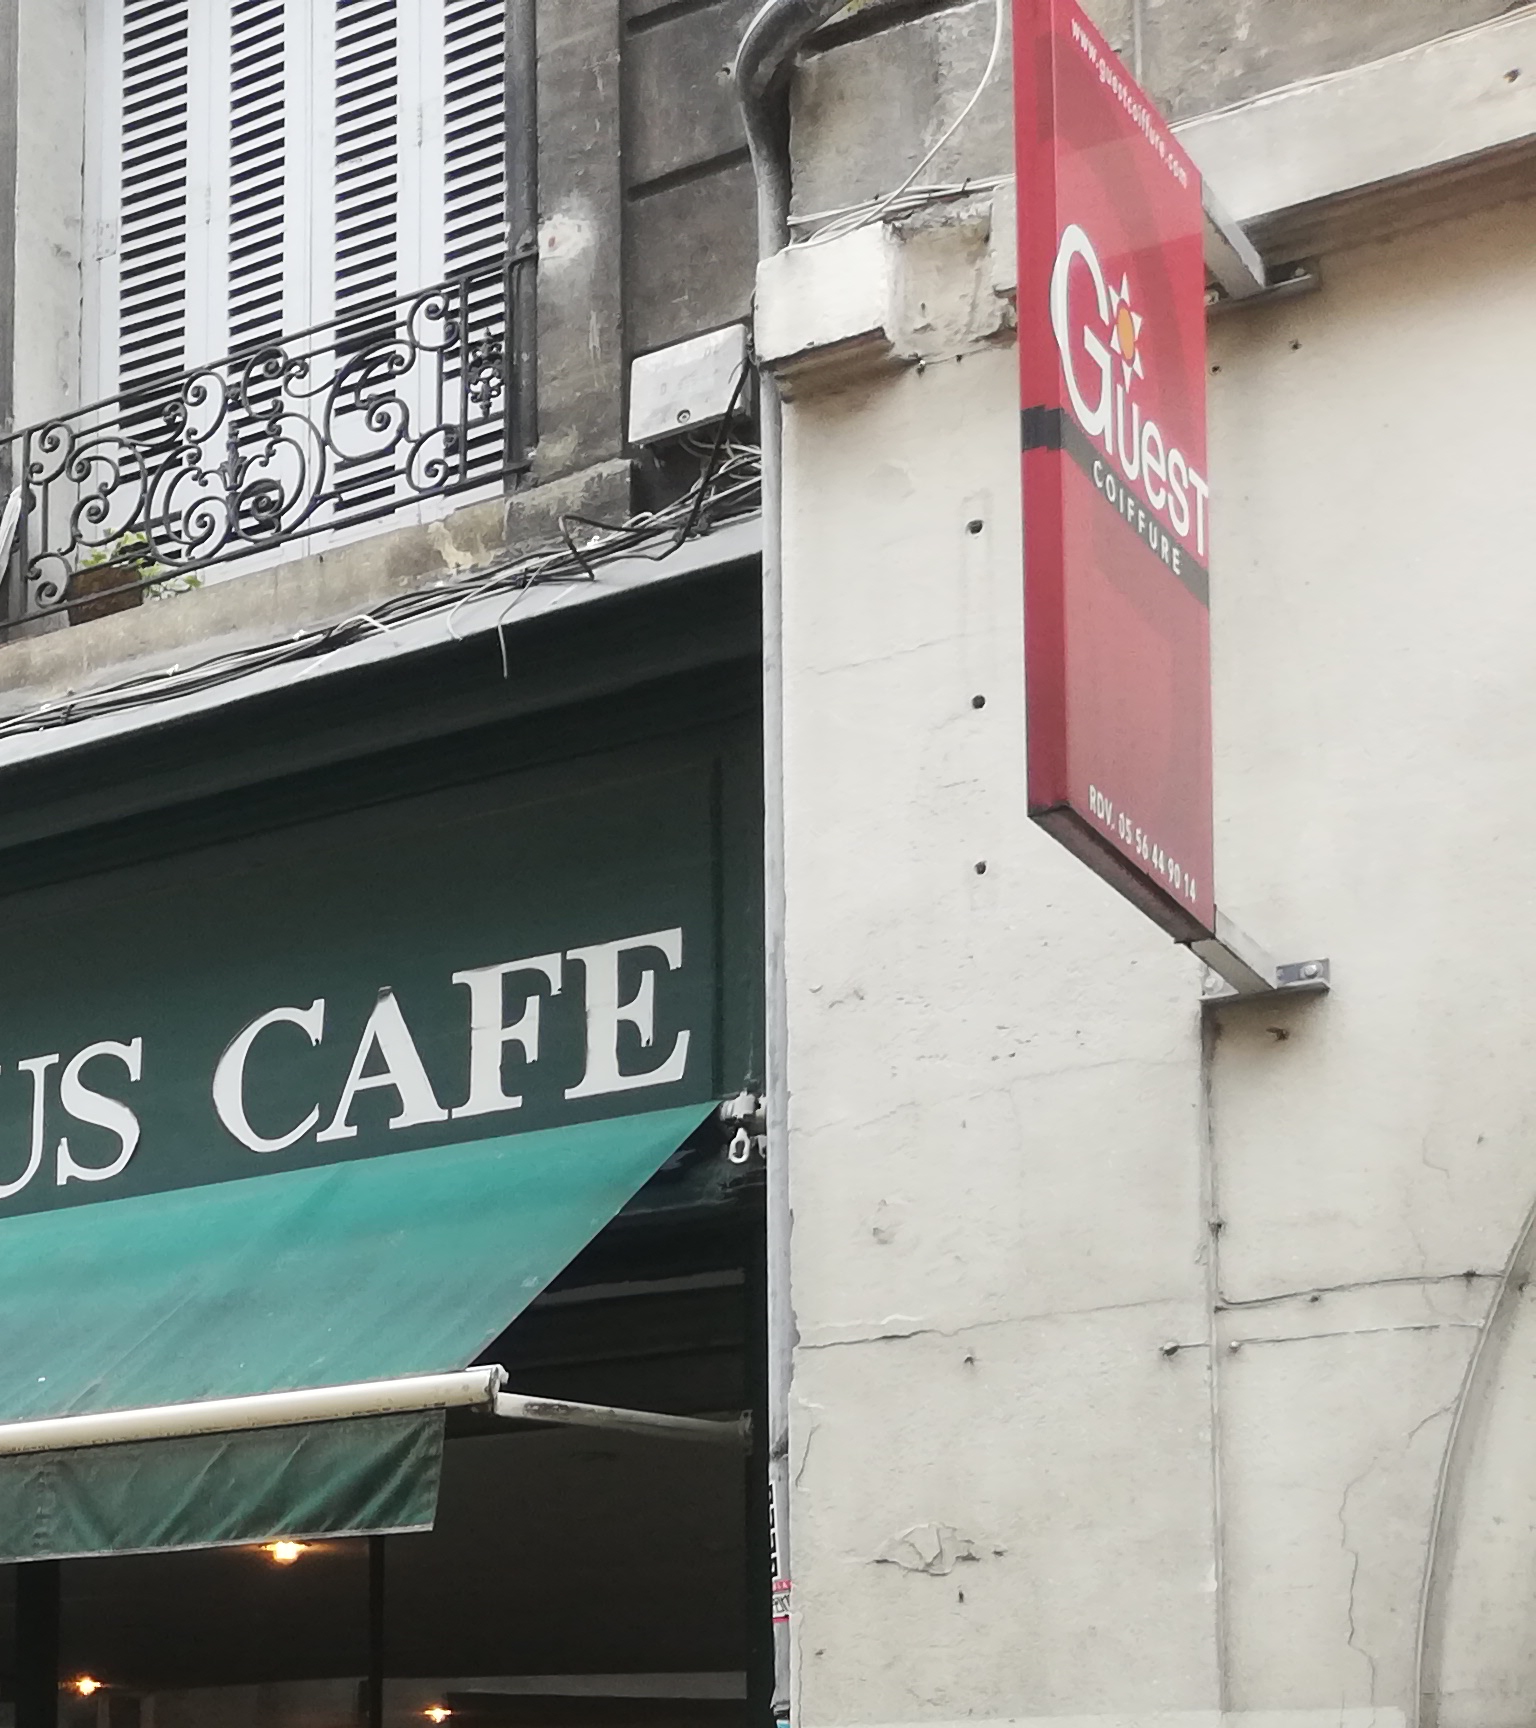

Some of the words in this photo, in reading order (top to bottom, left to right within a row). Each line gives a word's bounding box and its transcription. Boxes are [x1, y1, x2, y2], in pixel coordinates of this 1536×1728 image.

[1092, 460, 1181, 576] COIFFURE
[1089, 784, 1115, 830] RDV.
[1118, 812, 1132, 845] 05
[1136, 827, 1149, 860] 56
[1151, 843, 1165, 875] 44
[1167, 857, 1181, 889] 90
[1184, 872, 1196, 903] 14
[212, 927, 691, 1154] CAFE
